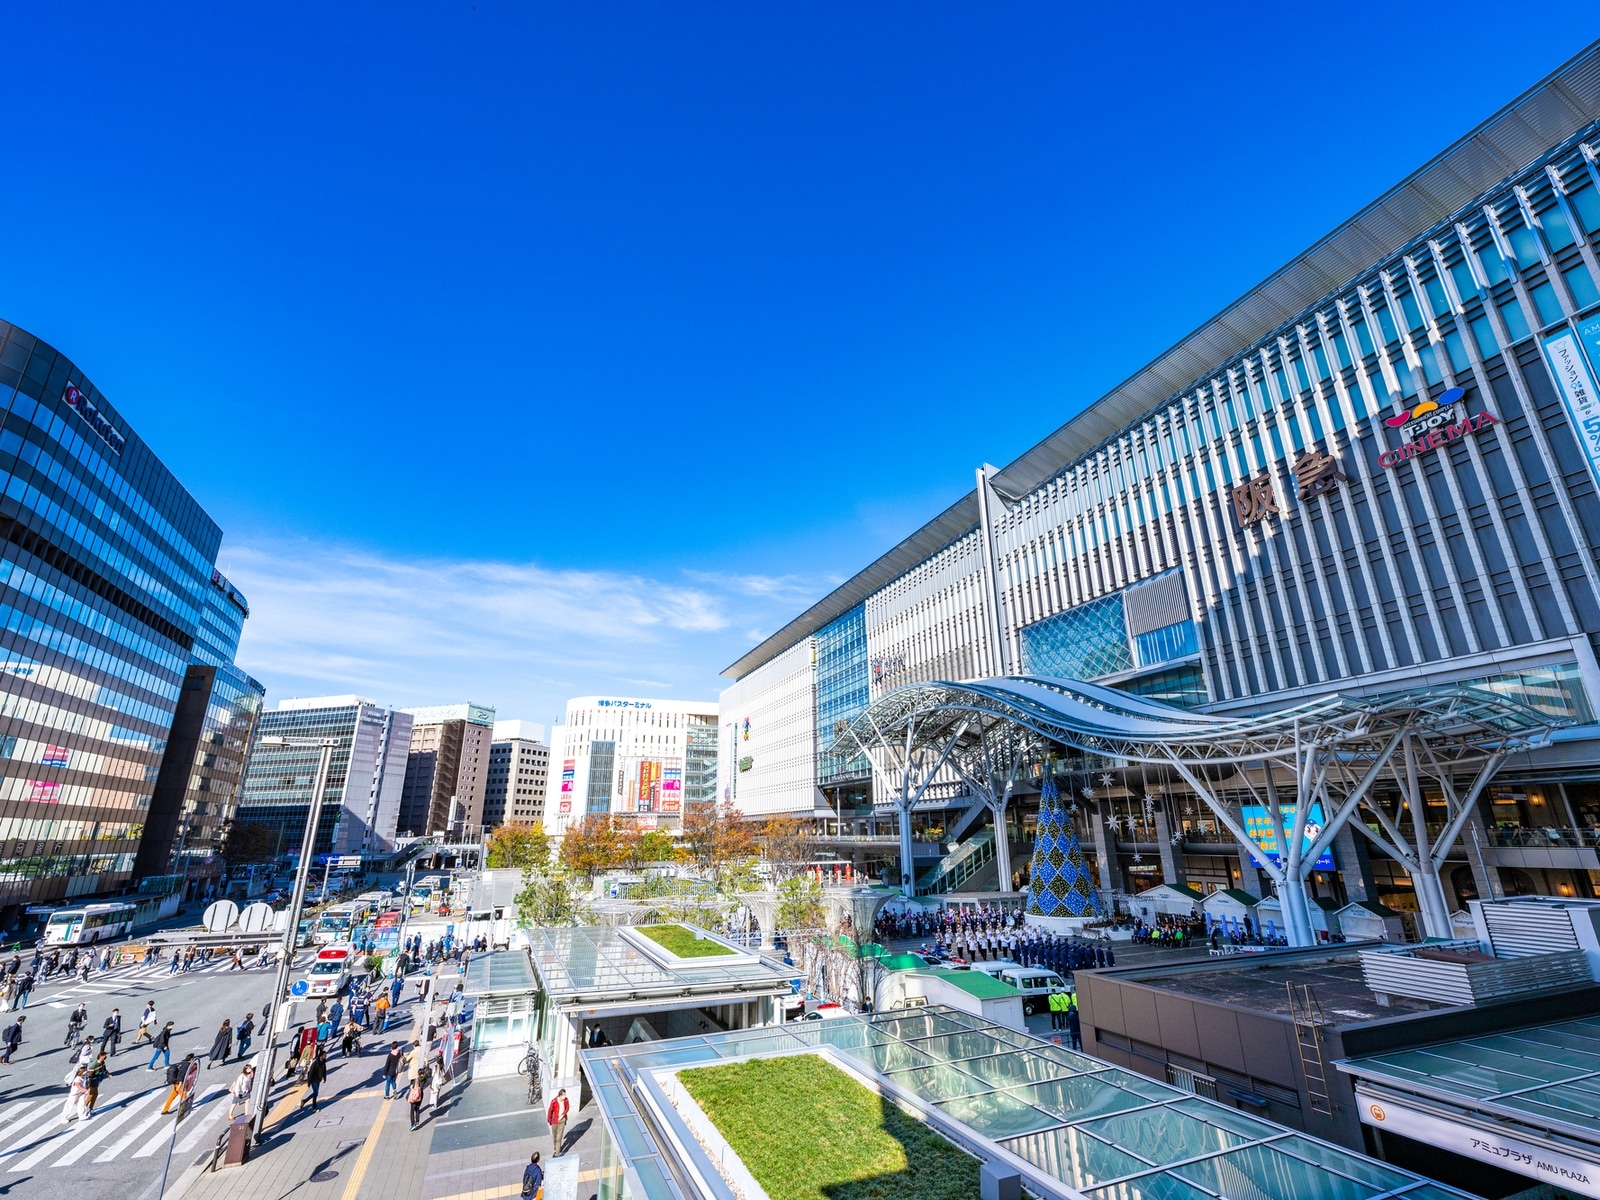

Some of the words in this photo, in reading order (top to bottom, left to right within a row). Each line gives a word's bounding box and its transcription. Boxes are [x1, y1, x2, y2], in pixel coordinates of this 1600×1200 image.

[75, 395, 123, 454] Rakuten
[1377, 410, 1499, 468] CINEMA
[1232, 451, 1347, 528] 阪急
[598, 699, 652, 709] 博多バスターミナル
[1470, 1137, 1533, 1165] アミュプラザ
[1536, 1160, 1559, 1175] AMU
[1560, 1168, 1591, 1185] PLAZA
